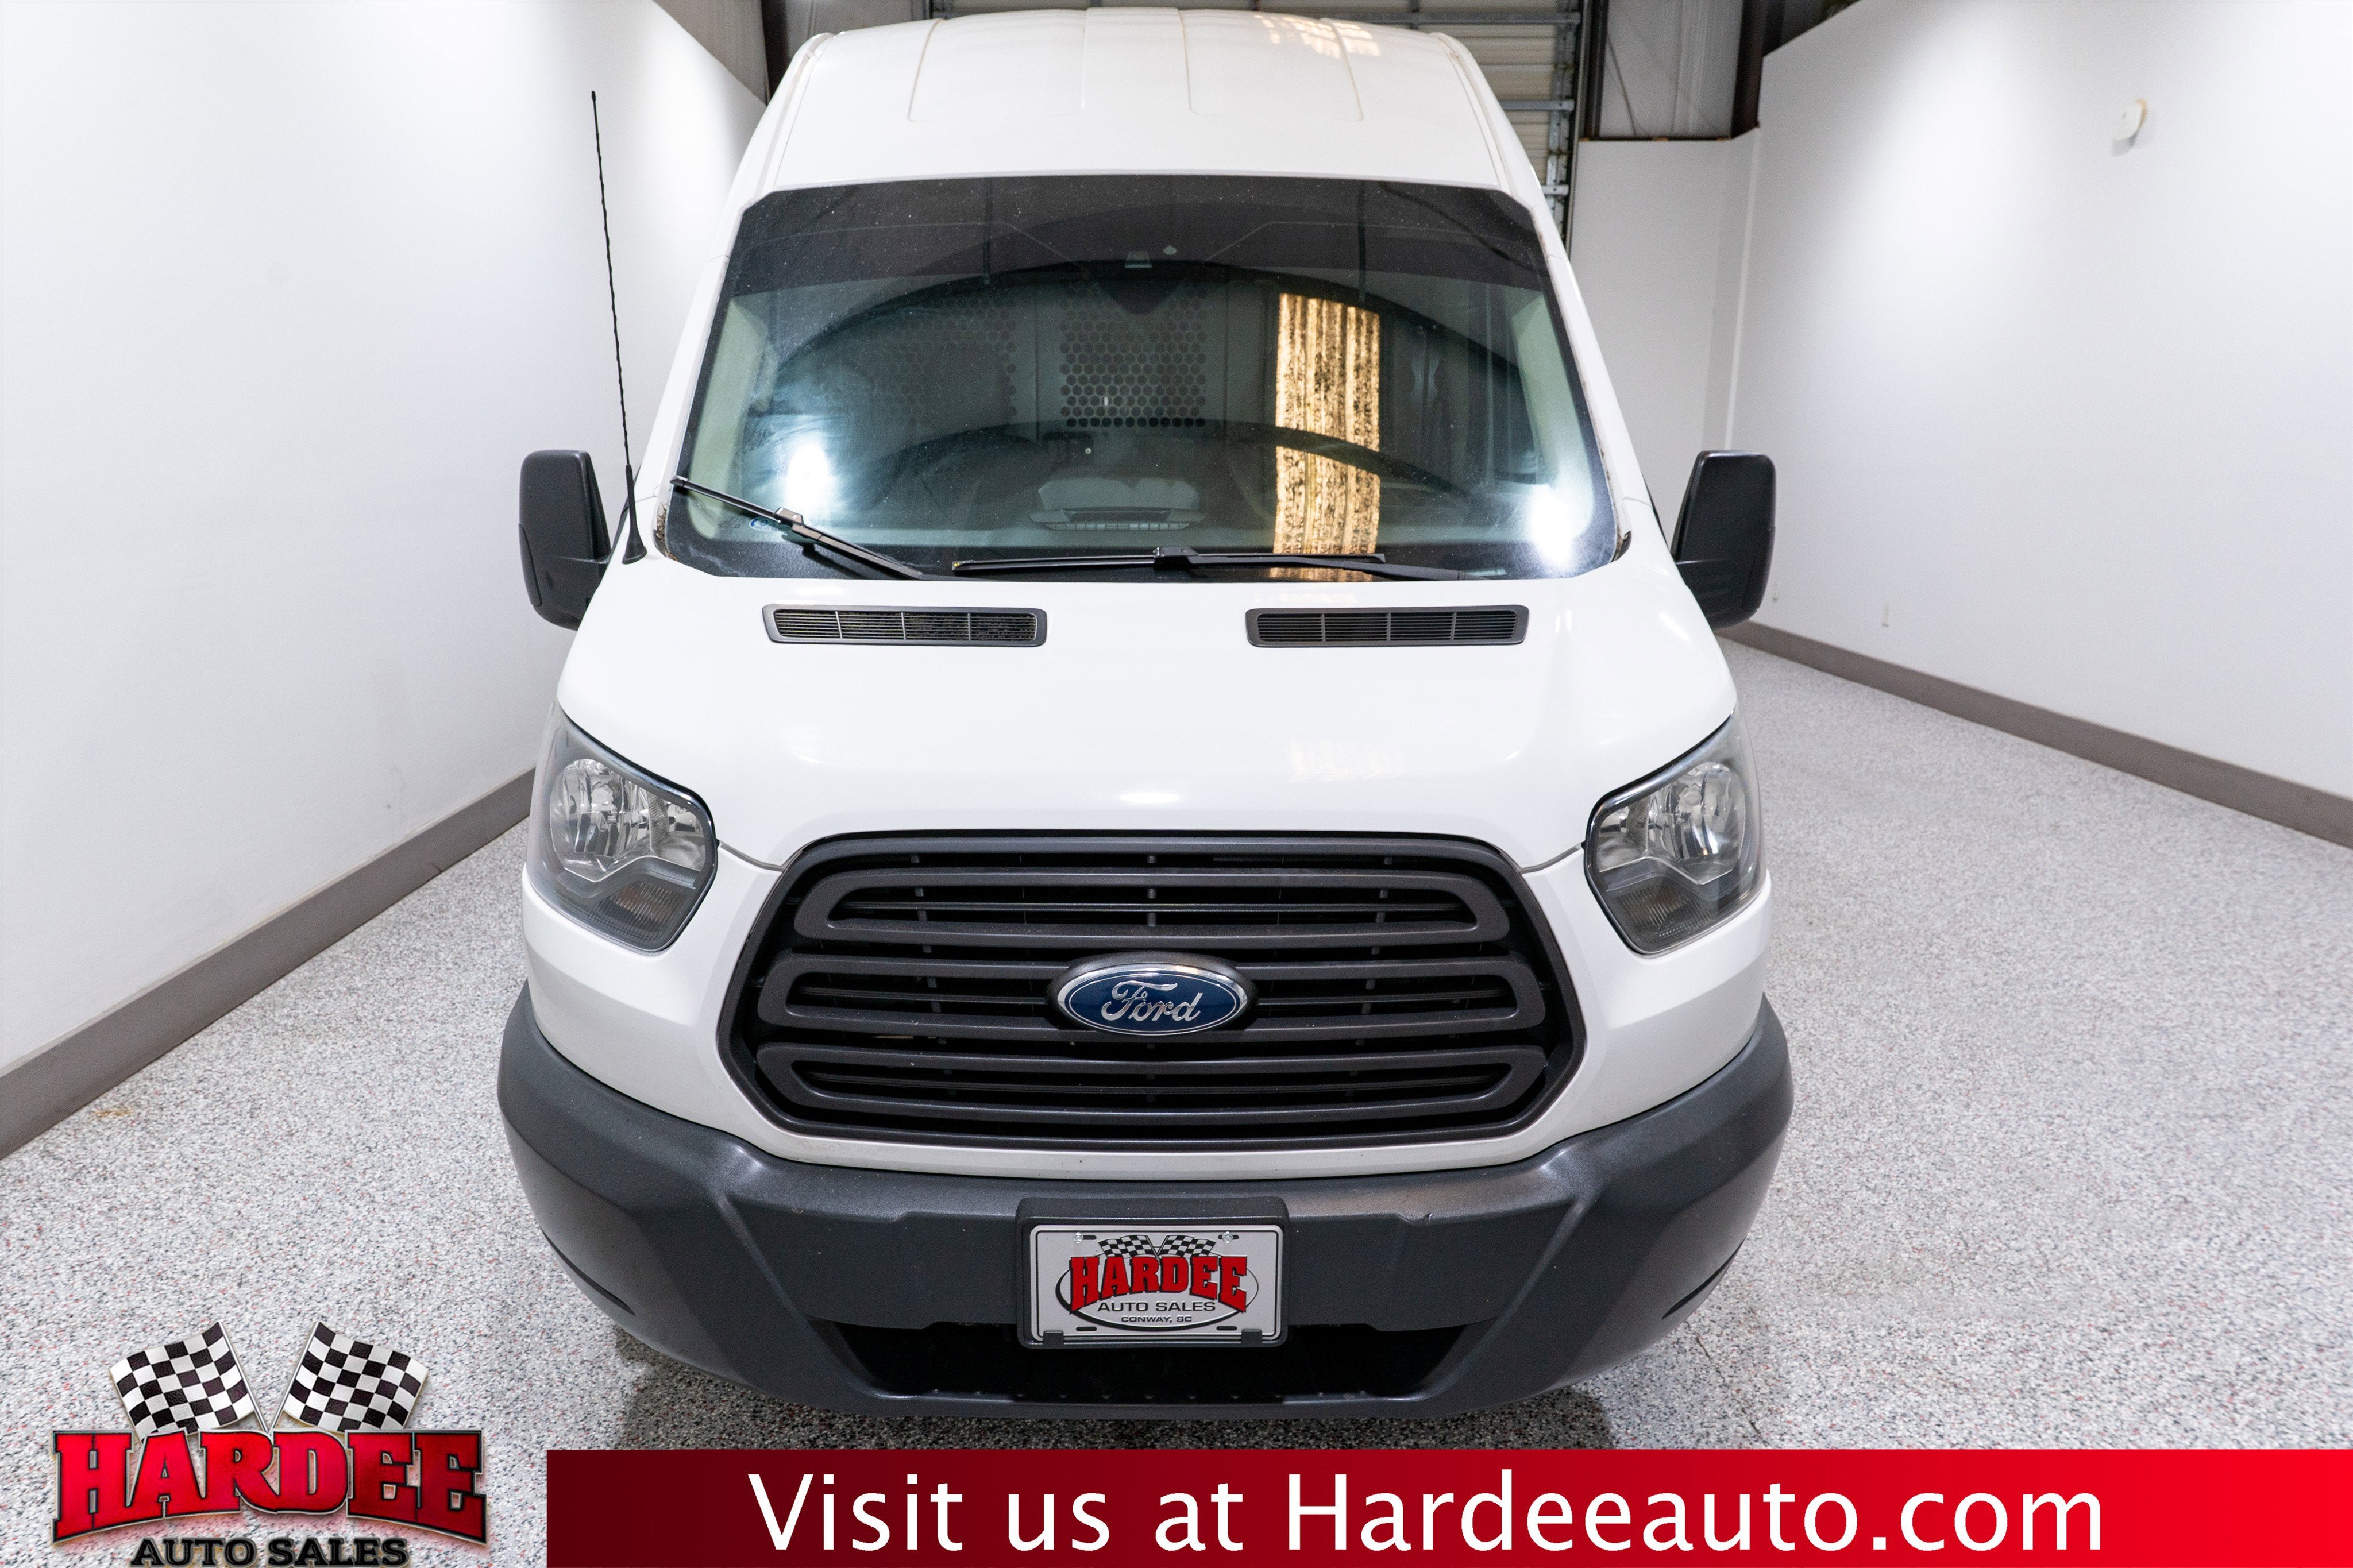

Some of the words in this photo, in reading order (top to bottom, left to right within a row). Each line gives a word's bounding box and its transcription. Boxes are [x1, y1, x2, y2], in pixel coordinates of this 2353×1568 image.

[1101, 980, 1203, 1021] Ford
[1069, 1256, 1247, 1313] HARDEE
[1097, 1301, 1148, 1312] AUTO
[1156, 1301, 1216, 1312] SALES
[1121, 1315, 1173, 1323] CONWAY,
